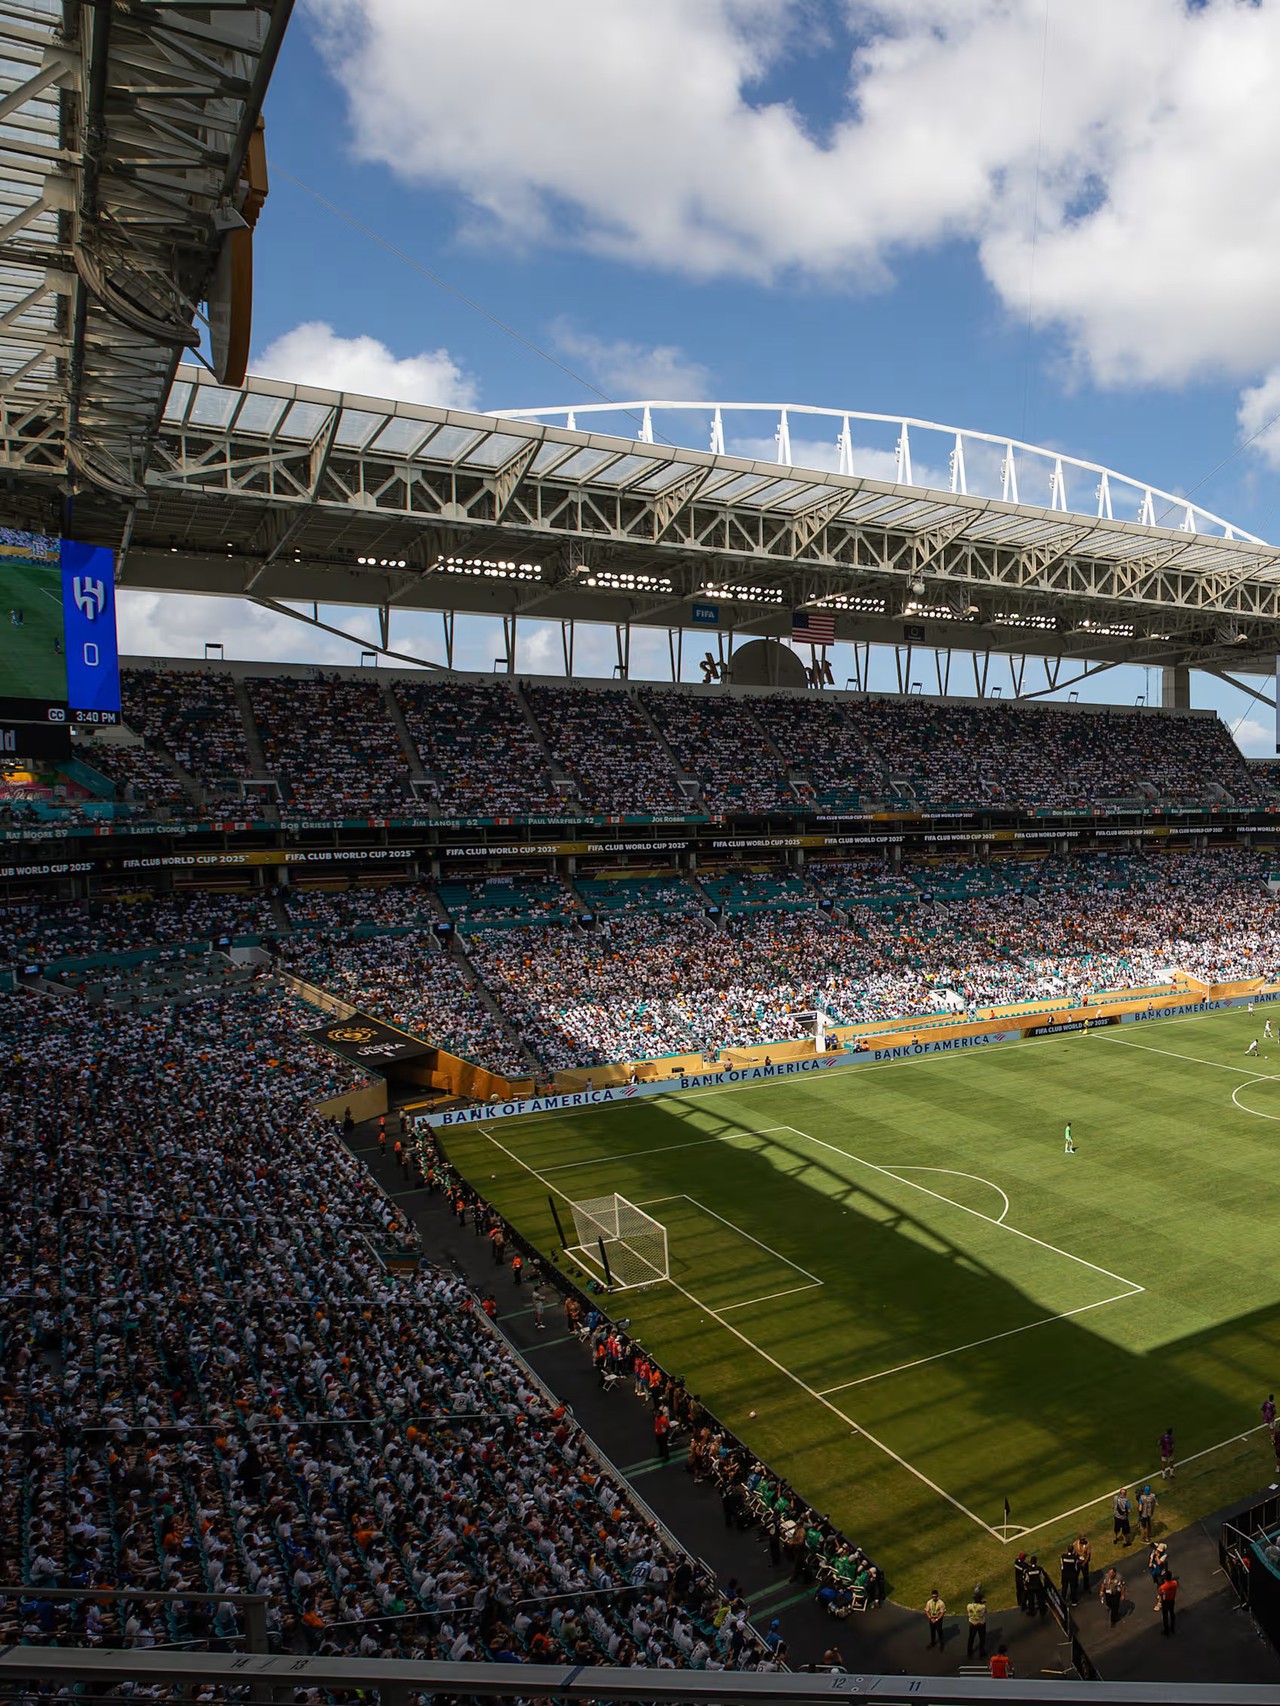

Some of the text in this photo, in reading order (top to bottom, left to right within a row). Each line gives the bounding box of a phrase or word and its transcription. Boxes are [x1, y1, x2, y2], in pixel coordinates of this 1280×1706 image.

[696, 609, 715, 618] FIFA
[83, 643, 99, 666] 0
[76, 711, 116, 723] 3:40 PM
[55, 830, 68, 838] 89
[123, 860, 141, 868] FIFA
[141, 857, 161, 866] CLUB
[161, 856, 195, 865] WORLD
[1254, 994, 1279, 1003] BANK
[1134, 1001, 1220, 1021] BANK OF AMERICA
[874, 1035, 990, 1060] BANK OF AMERICA
[681, 1060, 820, 1088] BANK OF AMERICA
[443, 1106, 496, 1124] BANK
[502, 1102, 526, 1115] OF
[531, 1090, 613, 1111] AMERICA
[230, 1658, 308, 1670] 14 13
[832, 1678, 922, 1692] 12 11
